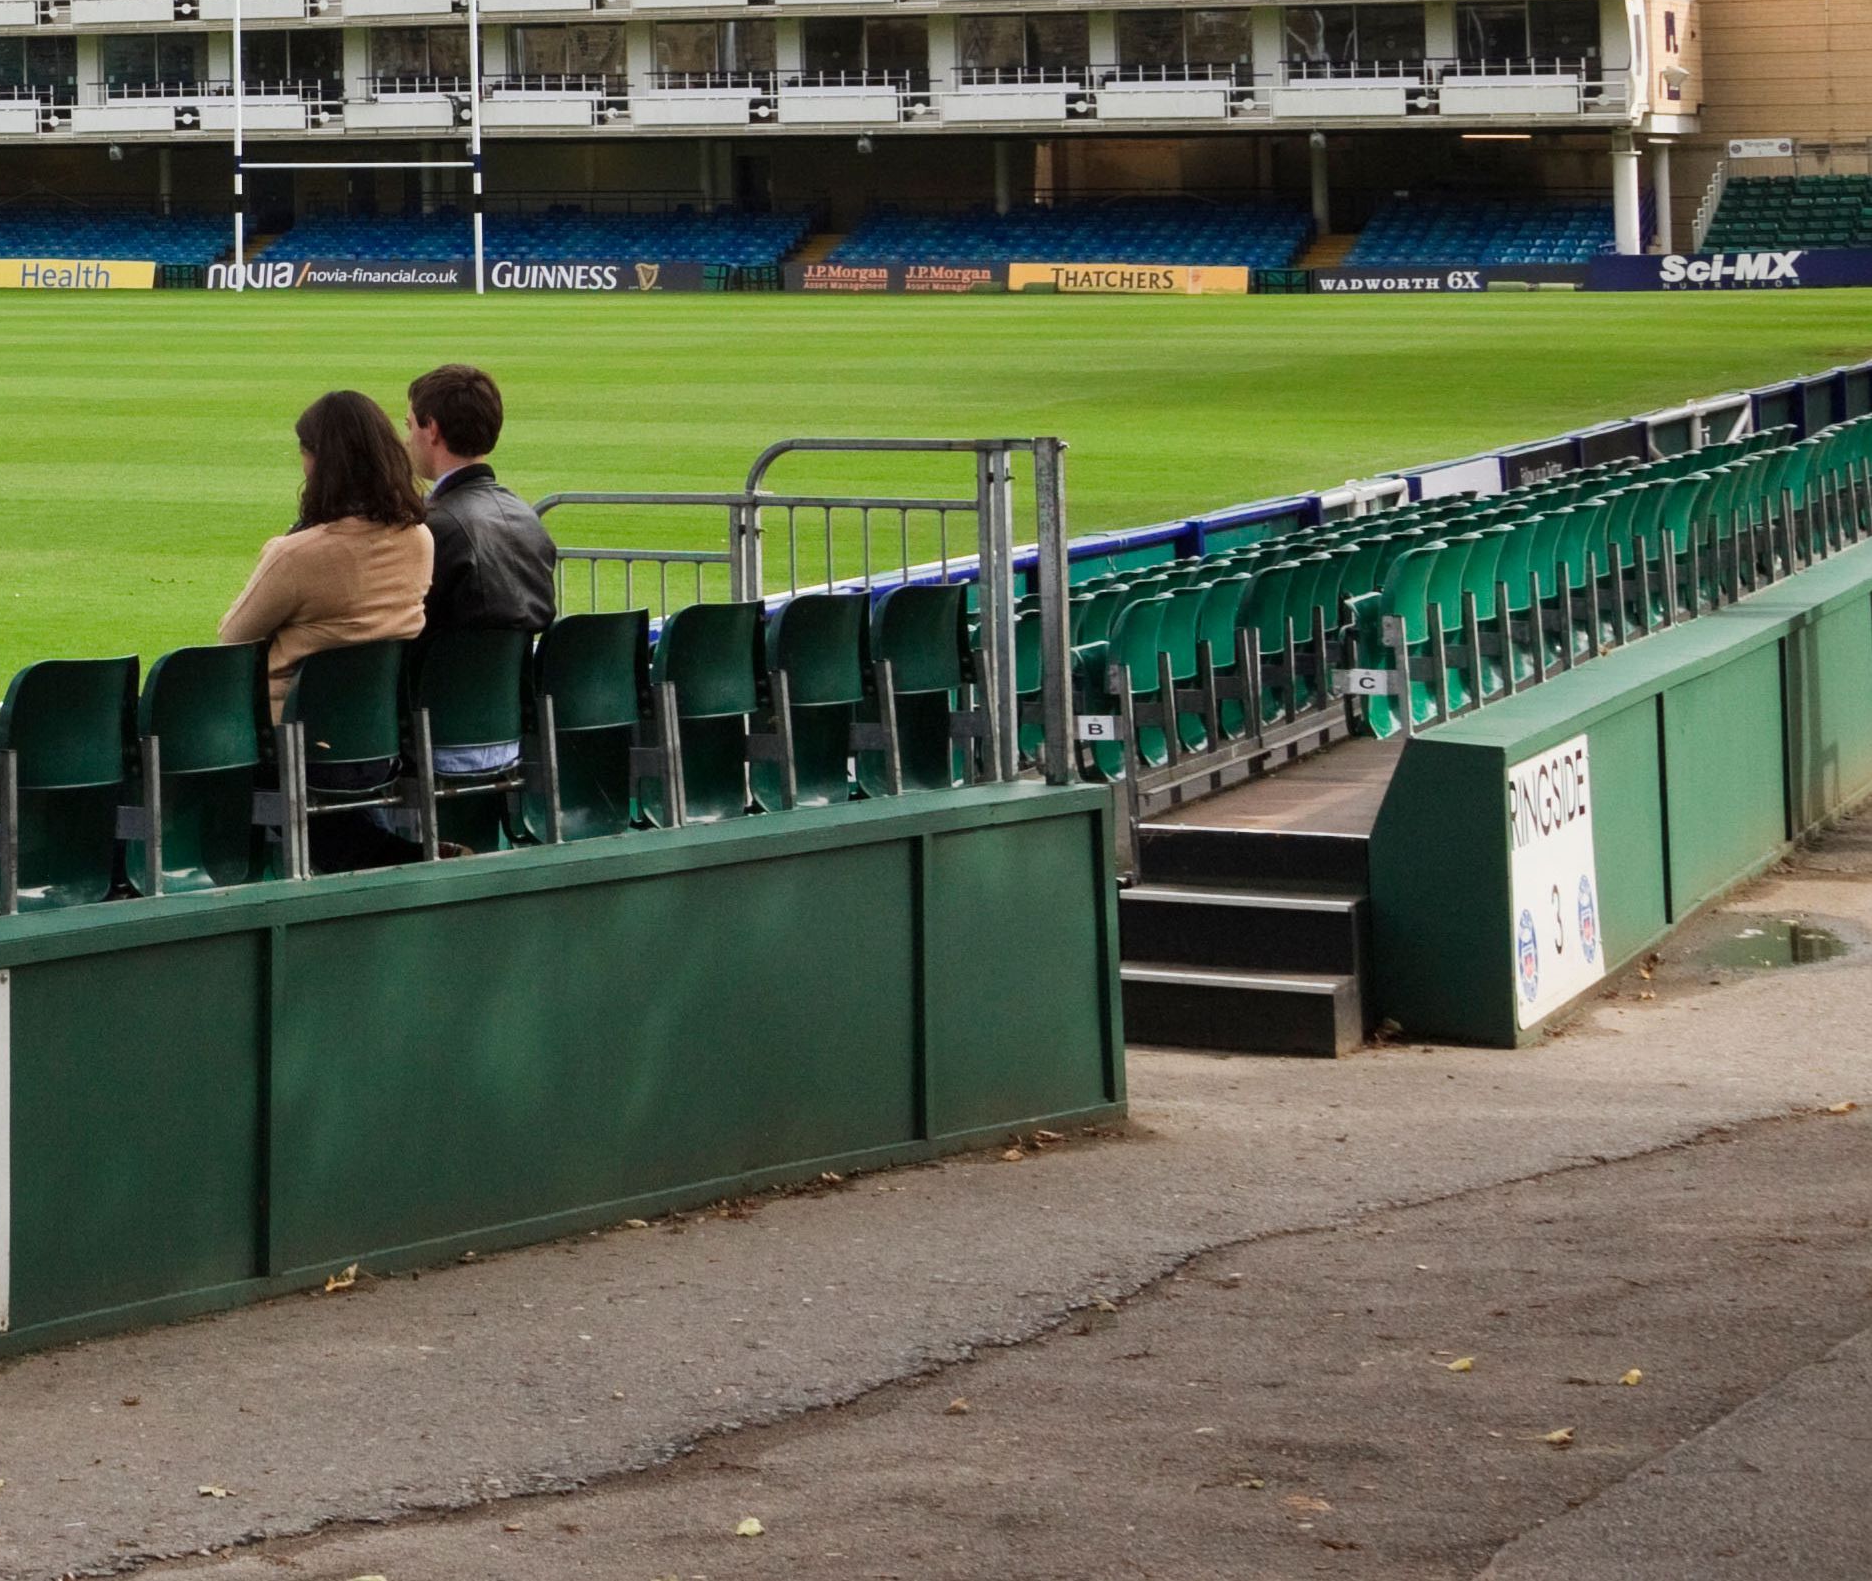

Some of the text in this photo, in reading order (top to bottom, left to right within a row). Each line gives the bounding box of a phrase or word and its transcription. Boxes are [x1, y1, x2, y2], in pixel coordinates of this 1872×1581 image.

[804, 265, 888, 282] J.P.Morgan
[905, 265, 991, 282] J.P.Morgan
[1659, 250, 1803, 282] Sci-MX
[21, 262, 110, 288] Health
[307, 267, 457, 284] novia-financial.co.uk
[491, 261, 617, 290] GUINNESS
[1051, 268, 1174, 290] THATCHERS
[1320, 271, 1479, 291] WADWORTH 6X
[1663, 278, 1800, 289] NUTRITION
[804, 281, 887, 290] Asset Management
[905, 281, 971, 291] Asset Manage
[1359, 677, 1375, 689] C
[1088, 723, 1103, 735] B
[1509, 749, 1585, 850] RINGSIDE
[1552, 884, 1564, 954] 3
